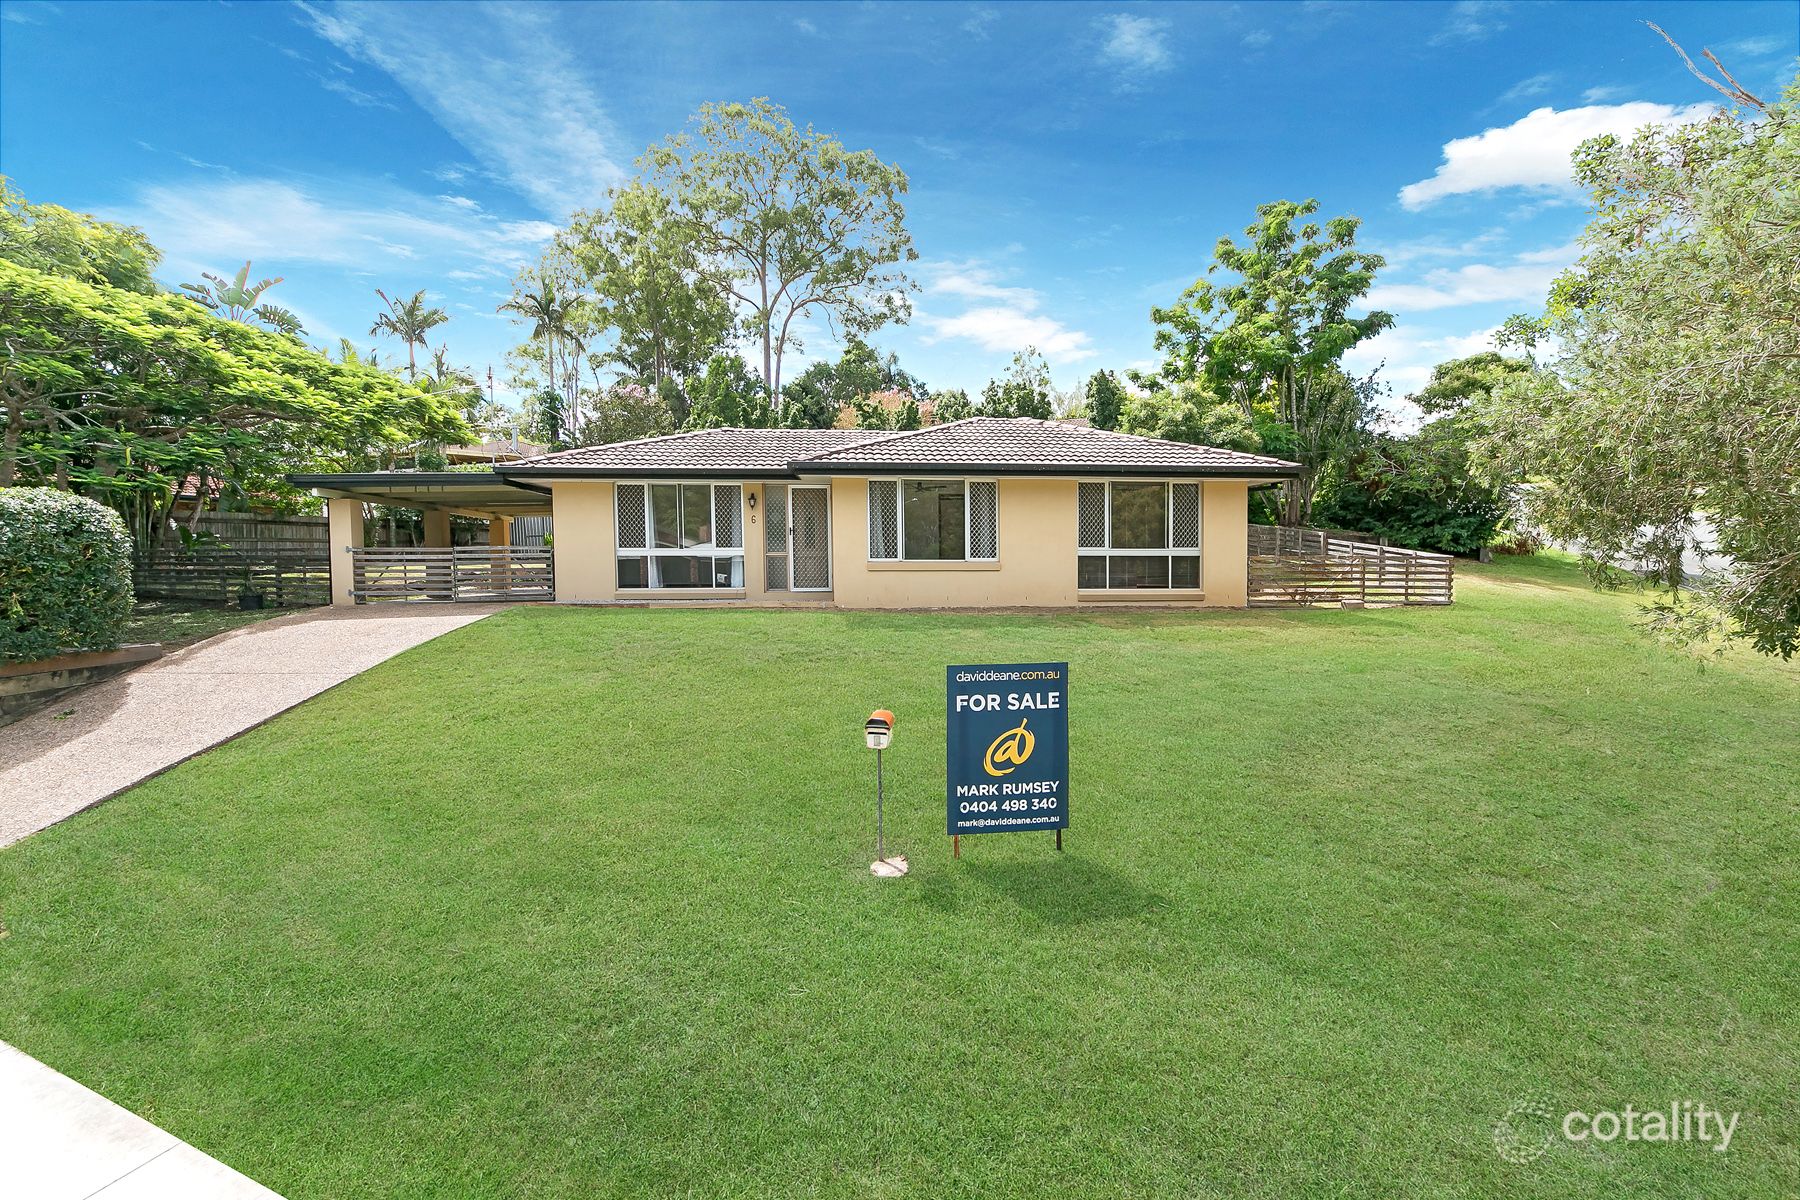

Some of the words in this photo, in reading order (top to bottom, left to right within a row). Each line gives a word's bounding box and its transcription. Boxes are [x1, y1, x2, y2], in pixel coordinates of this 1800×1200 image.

[751, 515, 757, 524] 6
[956, 669, 1060, 682] daviddeane.com.au
[956, 694, 1000, 712] FOR
[1007, 692, 1060, 711] SALE
[957, 784, 999, 797] MARK
[1002, 781, 1060, 795] RUMSEY
[960, 801, 998, 813] 0404
[1002, 799, 1028, 812] 498
[1031, 797, 1057, 811] 340
[957, 815, 1060, 828] mark@daviddeane.com.au
